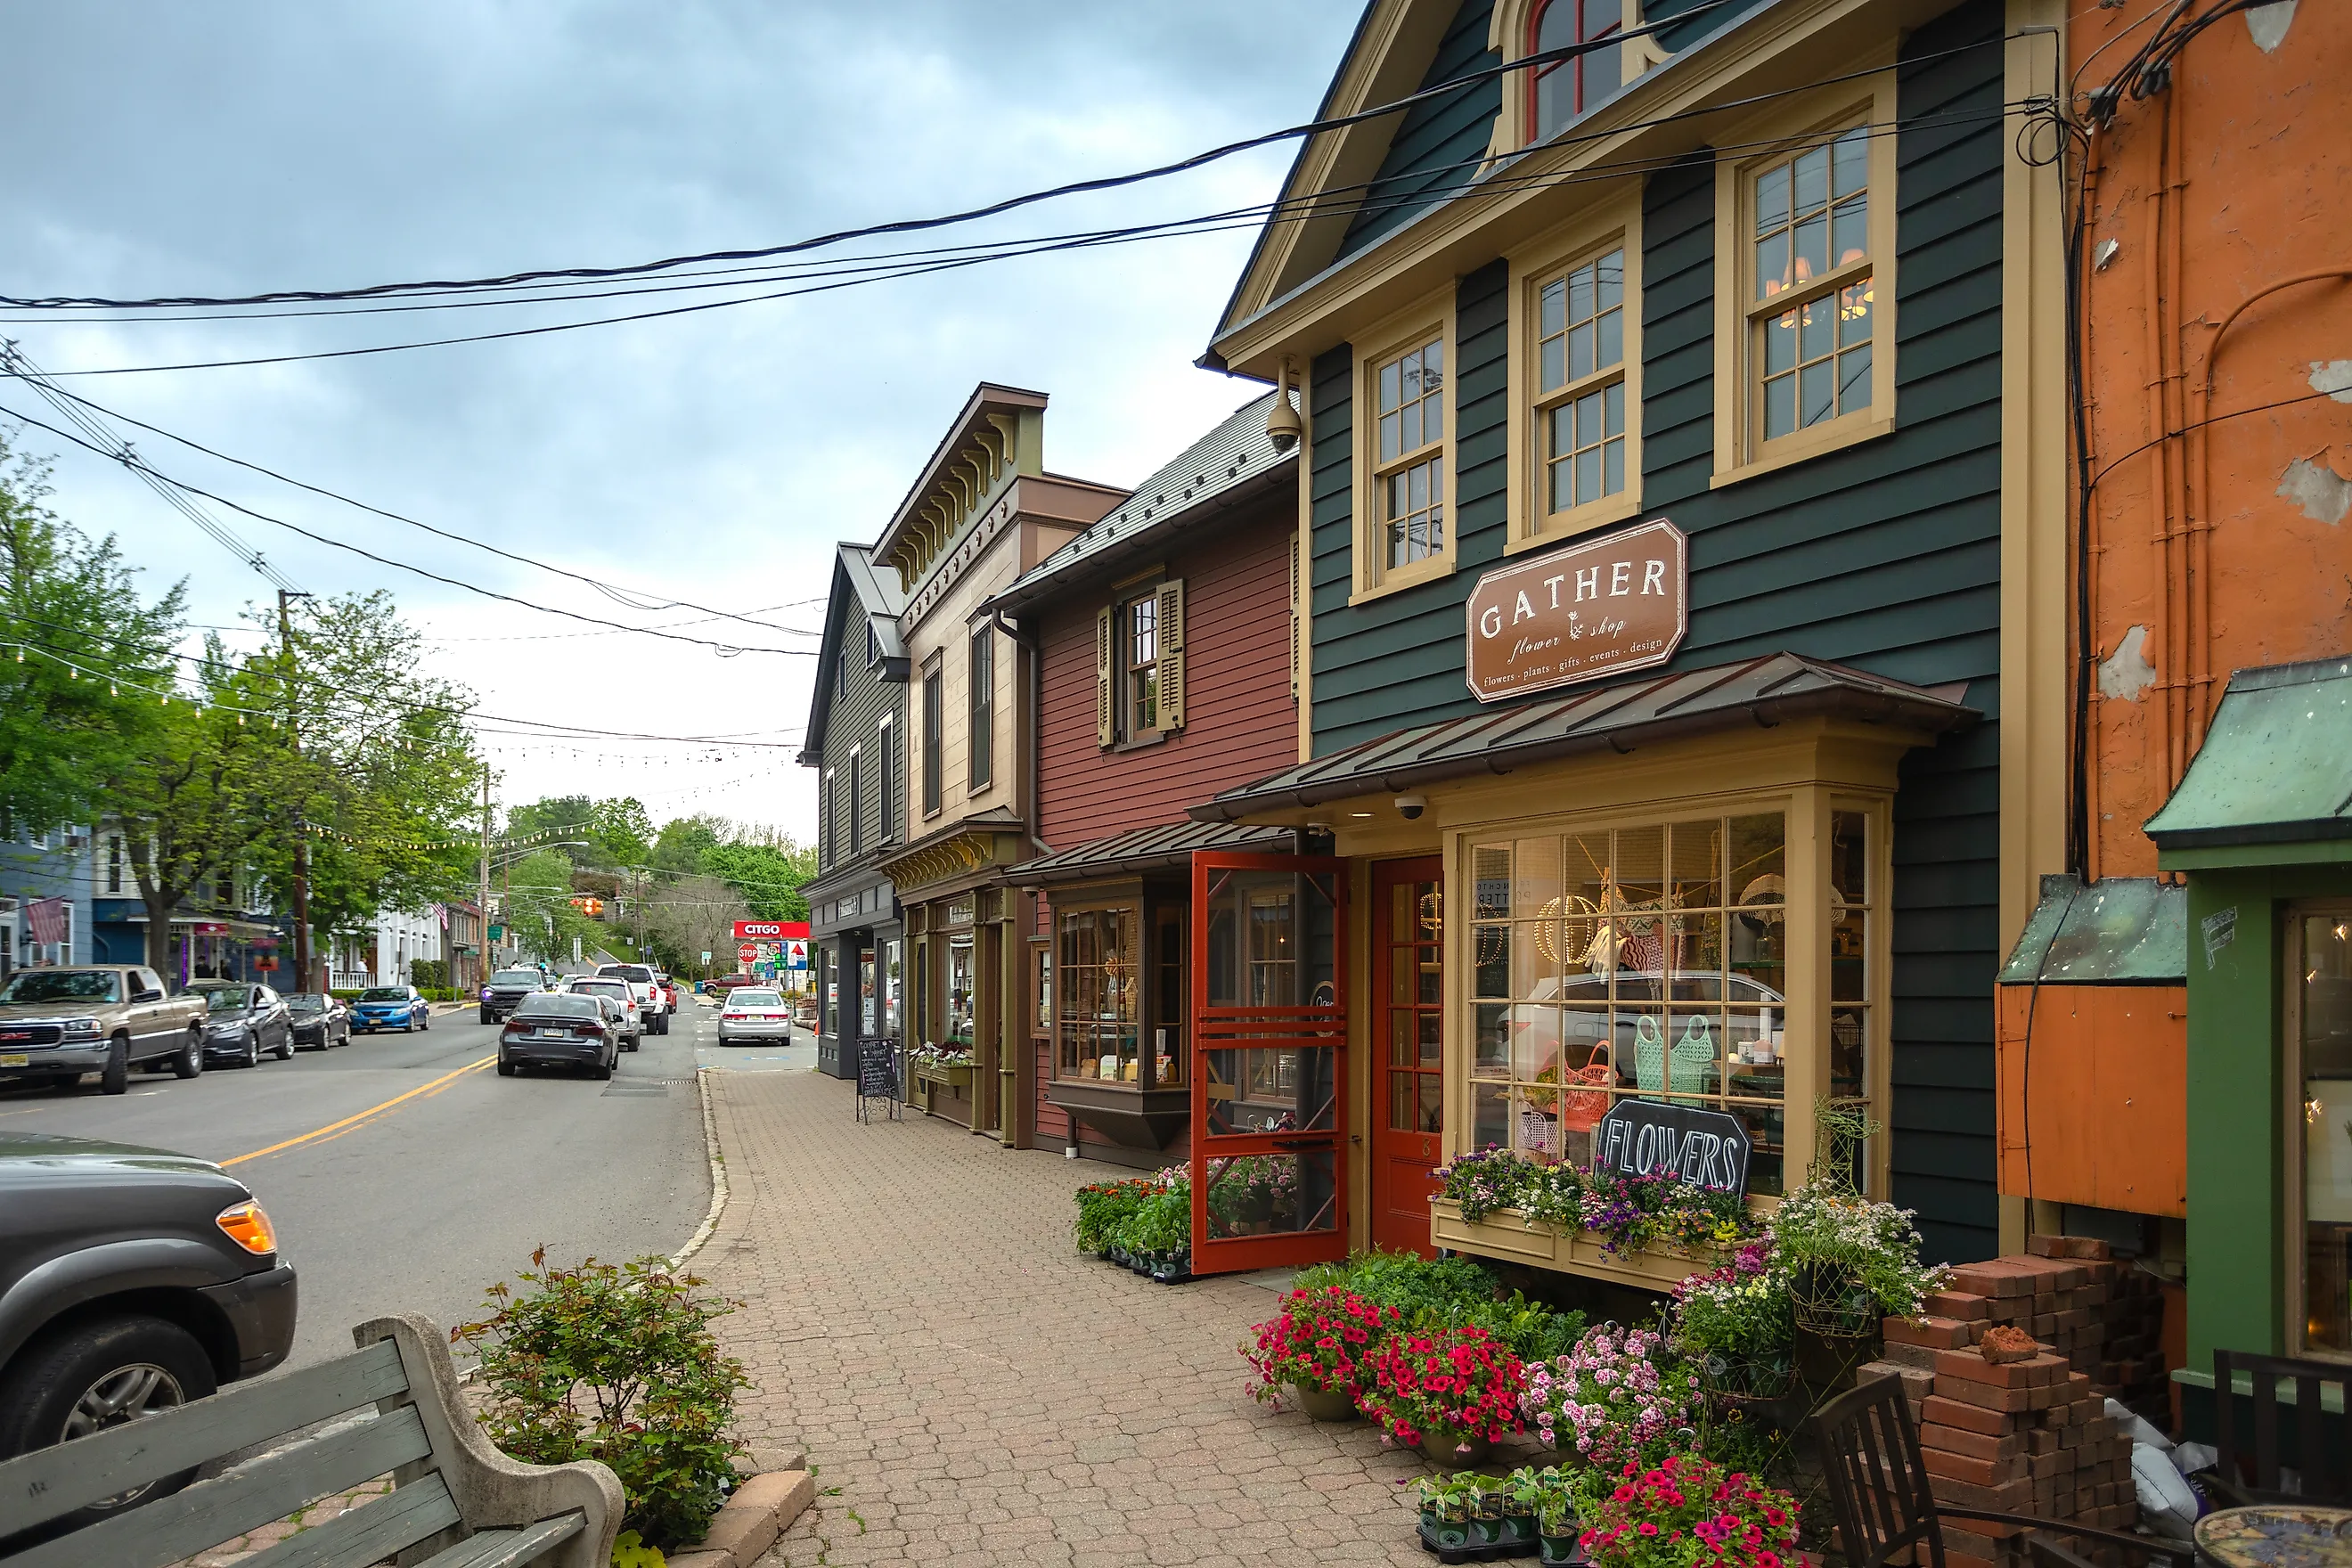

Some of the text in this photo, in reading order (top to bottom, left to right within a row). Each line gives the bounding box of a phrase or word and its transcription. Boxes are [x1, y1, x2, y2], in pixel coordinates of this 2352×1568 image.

[1480, 559, 1665, 639] GATHER
[1483, 638, 1663, 687] flowers plants gifts events design
[1507, 616, 1627, 665] flower shop
[744, 925, 780, 934] CITGO
[1604, 1118, 1738, 1190] FLOWERS
